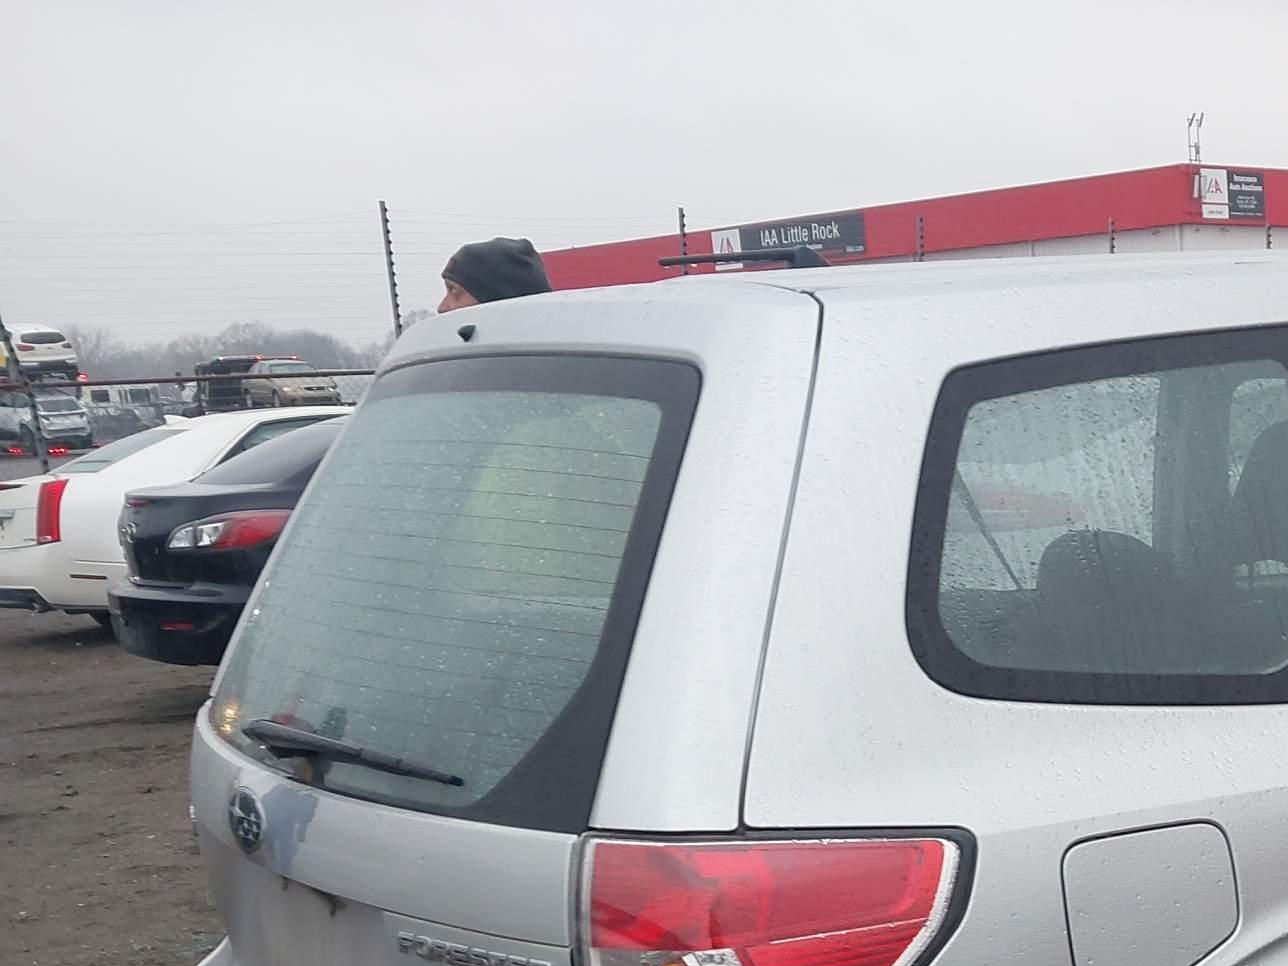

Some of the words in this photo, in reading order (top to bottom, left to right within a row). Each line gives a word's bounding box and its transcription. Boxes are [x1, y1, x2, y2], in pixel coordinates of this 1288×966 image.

[760, 229, 778, 246] IAA
[781, 226, 809, 244] Little
[812, 220, 840, 240] Rock
